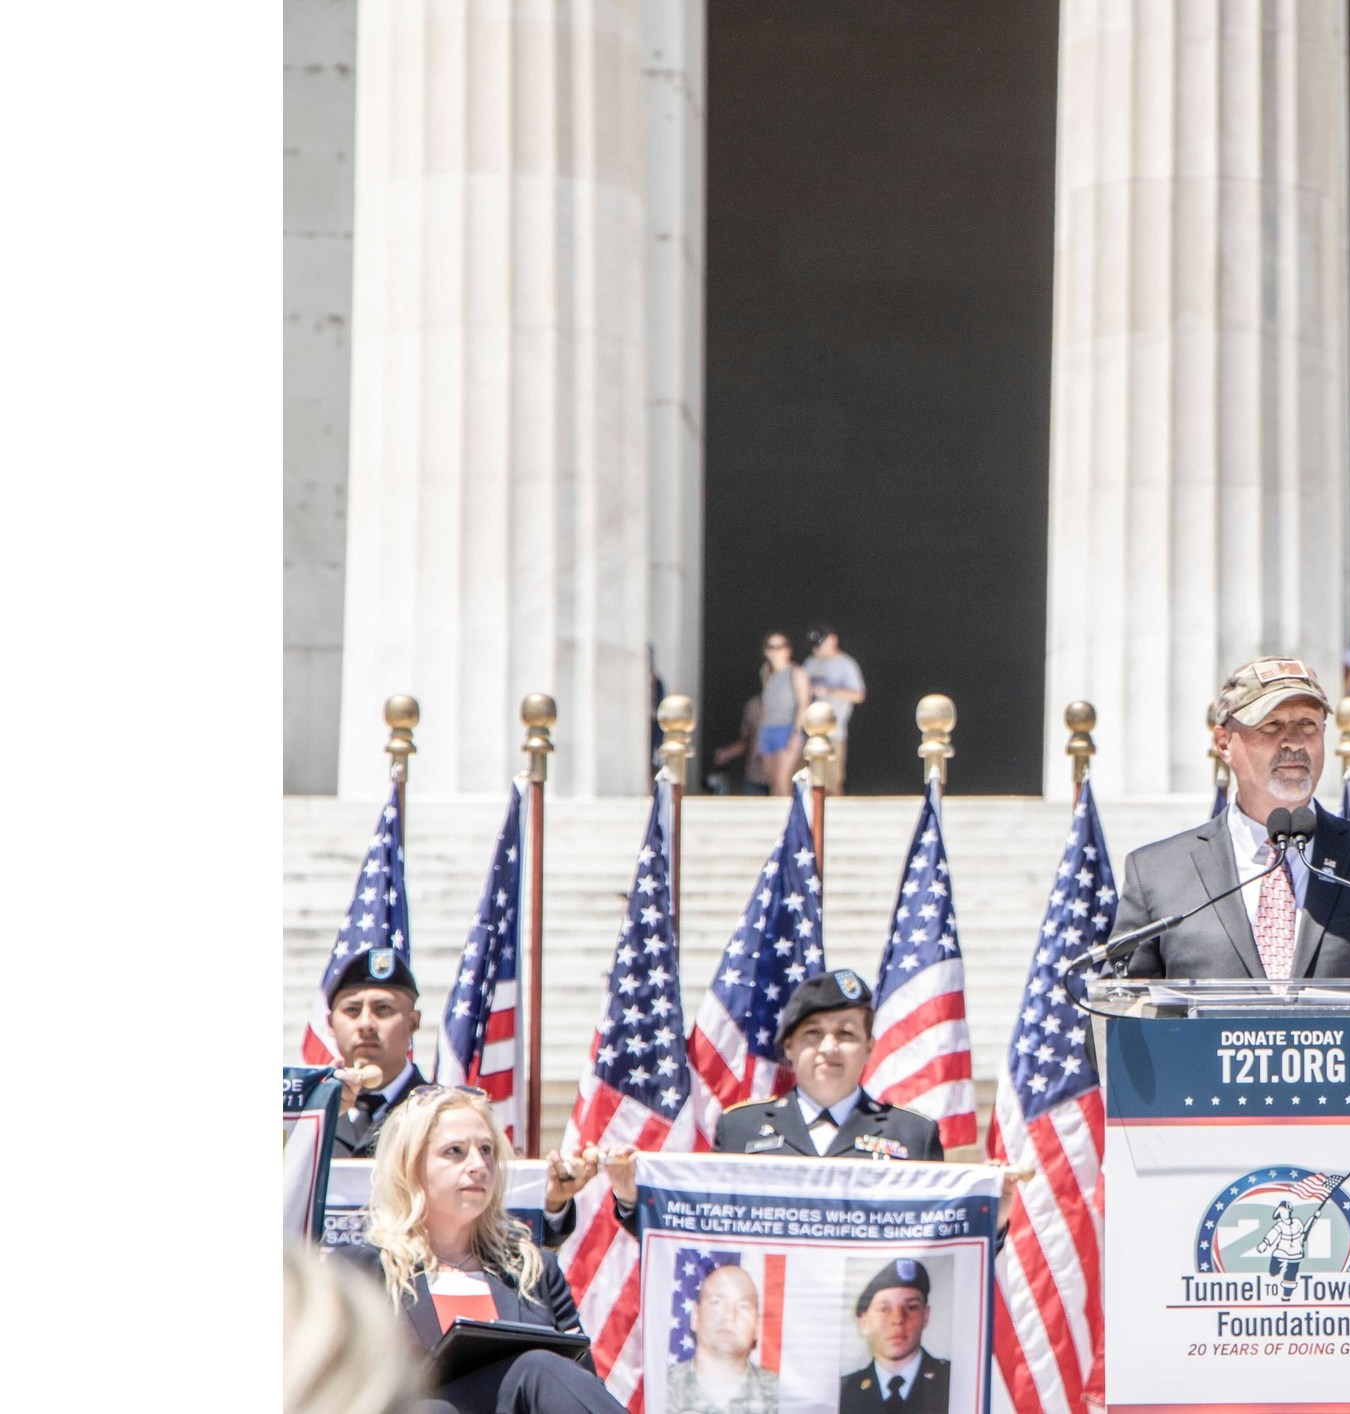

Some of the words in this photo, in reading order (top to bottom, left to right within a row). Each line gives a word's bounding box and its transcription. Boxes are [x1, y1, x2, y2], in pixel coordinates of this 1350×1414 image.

[1221, 1031, 1287, 1046] DONATE
[1291, 1031, 1345, 1046] TODAY
[1217, 1048, 1346, 1084] T2T.ORG
[667, 1200, 746, 1219] MILITARY
[751, 1204, 821, 1222] HEROES
[826, 1210, 867, 1225] WHO
[870, 1211, 916, 1225] HAVE
[921, 1208, 967, 1225] MADE
[663, 1214, 697, 1230] THE
[700, 1218, 785, 1235] ULTIMATE
[788, 1222, 880, 1238] SACRIFICE
[883, 1224, 934, 1238] SINCE
[938, 1221, 969, 1237] 9/11
[1181, 1276, 1261, 1302] Tunnel
[1265, 1283, 1278, 1296] TO
[1218, 1311, 1350, 1337] Foundation
[1188, 1344, 1207, 1356] 20
[1213, 1343, 1259, 1356] YEARS
[1264, 1343, 1284, 1356] OF
[1287, 1343, 1336, 1356] DOING
